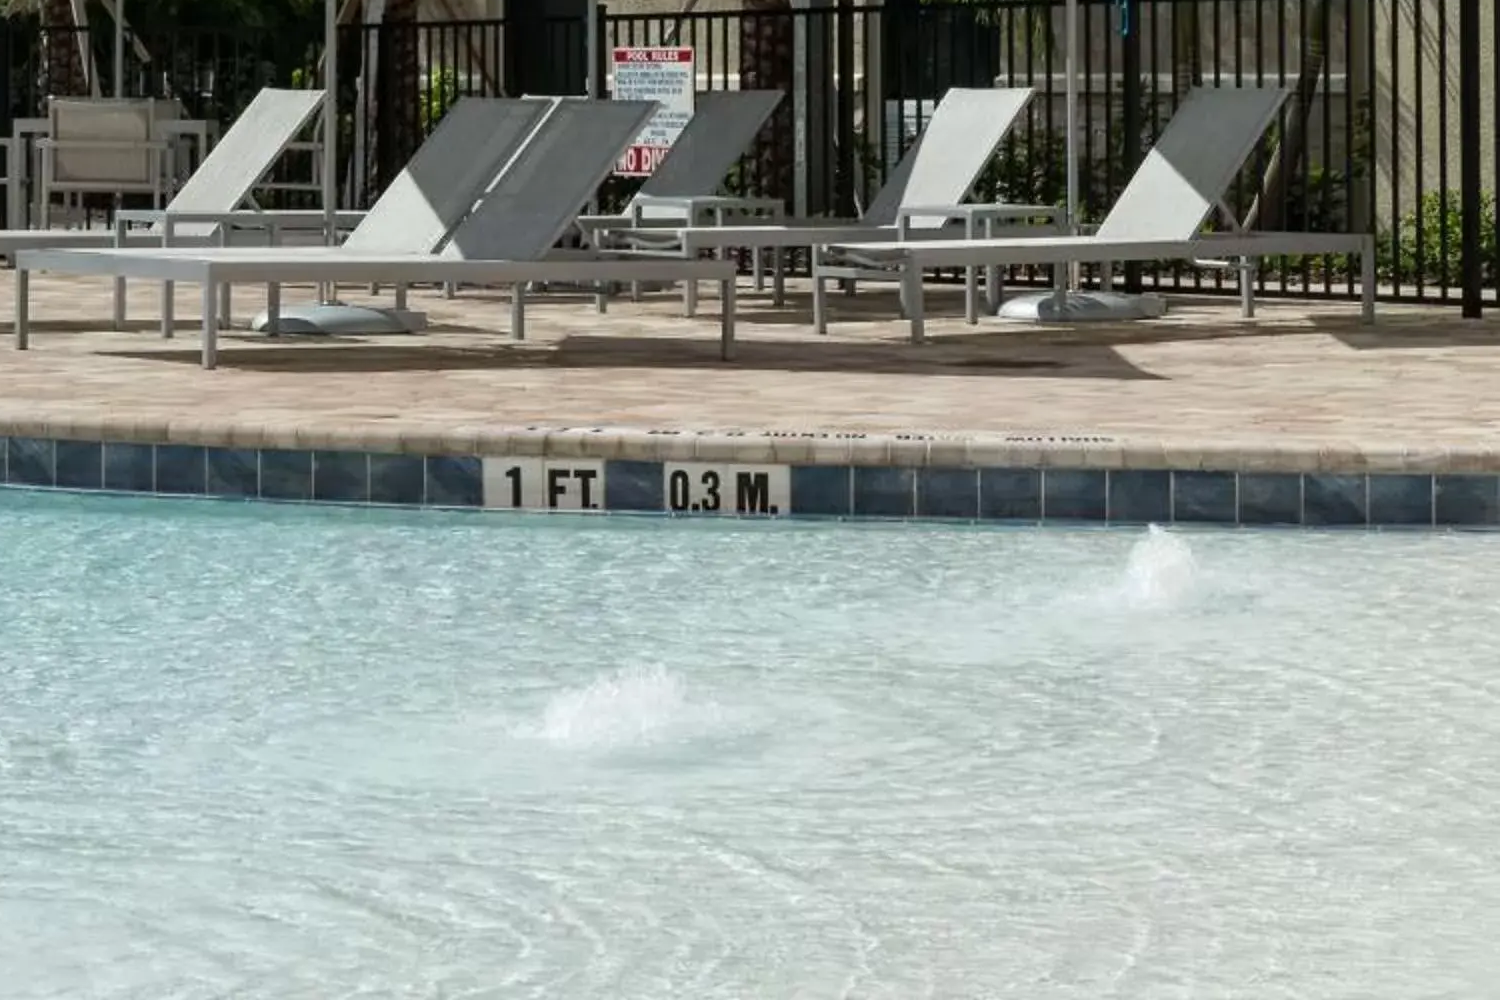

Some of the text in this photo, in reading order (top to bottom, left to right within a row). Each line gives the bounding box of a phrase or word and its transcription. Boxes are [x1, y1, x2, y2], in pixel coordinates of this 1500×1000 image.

[627, 51, 679, 61] POOL RULES
[641, 149, 669, 171] DIV
[505, 466, 598, 509] 1 FT.
[670, 470, 779, 514] 0.3 M.
